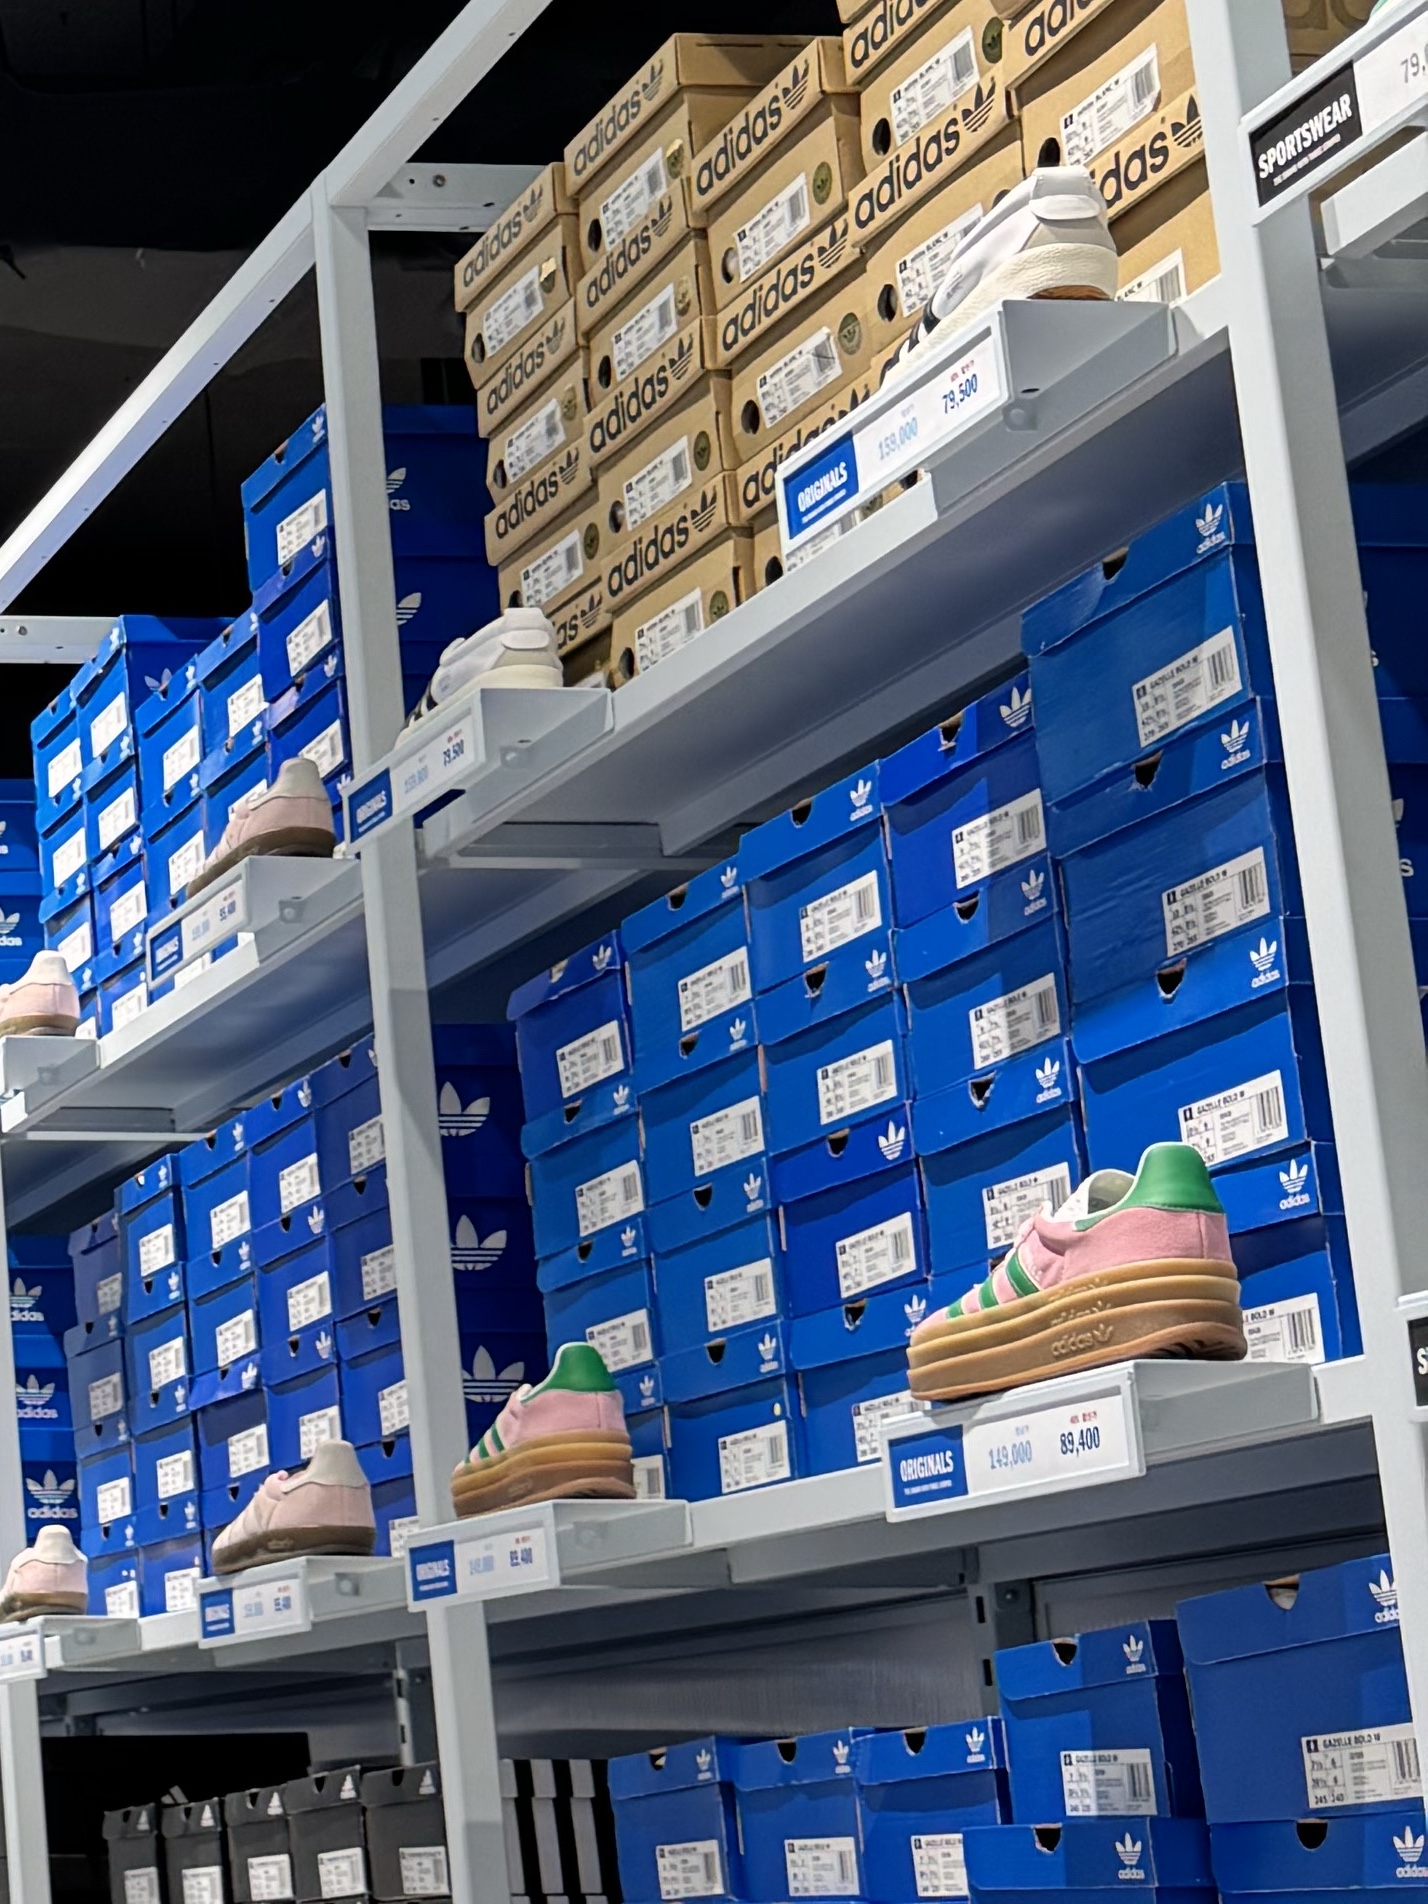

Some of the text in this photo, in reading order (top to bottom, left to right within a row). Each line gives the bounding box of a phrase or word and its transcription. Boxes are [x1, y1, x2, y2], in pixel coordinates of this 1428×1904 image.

[573, 97, 641, 177] adidas
[696, 95, 781, 196] adidas
[1258, 93, 1353, 179] SPORTSWEAR
[854, 121, 961, 229] adidas
[1090, 131, 1170, 211] das
[462, 214, 523, 289] adidas
[586, 228, 651, 309] adidas
[722, 254, 815, 351] adidas
[486, 341, 546, 416] adidas
[942, 373, 979, 415] 79,500
[589, 362, 669, 454] adidas
[495, 470, 559, 540] adidas
[797, 461, 847, 513] ORIGINALS
[608, 513, 689, 598] adidas
[1251, 969, 1280, 988] adidas
[1197, 1100, 1221, 1117] GAZELLE
[1223, 1094, 1238, 1107] BOLD
[1279, 1192, 1310, 1210] adidas
[10, 1310, 44, 1322] didas
[1250, 1310, 1266, 1323] BOLD
[1051, 1330, 1094, 1356] adidas
[989, 1440, 1033, 1471] 149,000
[1060, 1426, 1100, 1456] 89,400
[899, 1450, 954, 1482] ORIGINALS
[27, 1506, 78, 1519] adidas
[1323, 1735, 1352, 1749] GAZELLE
[1354, 1734, 1372, 1746] BOLD
[1118, 1868, 1145, 1880] adidas
